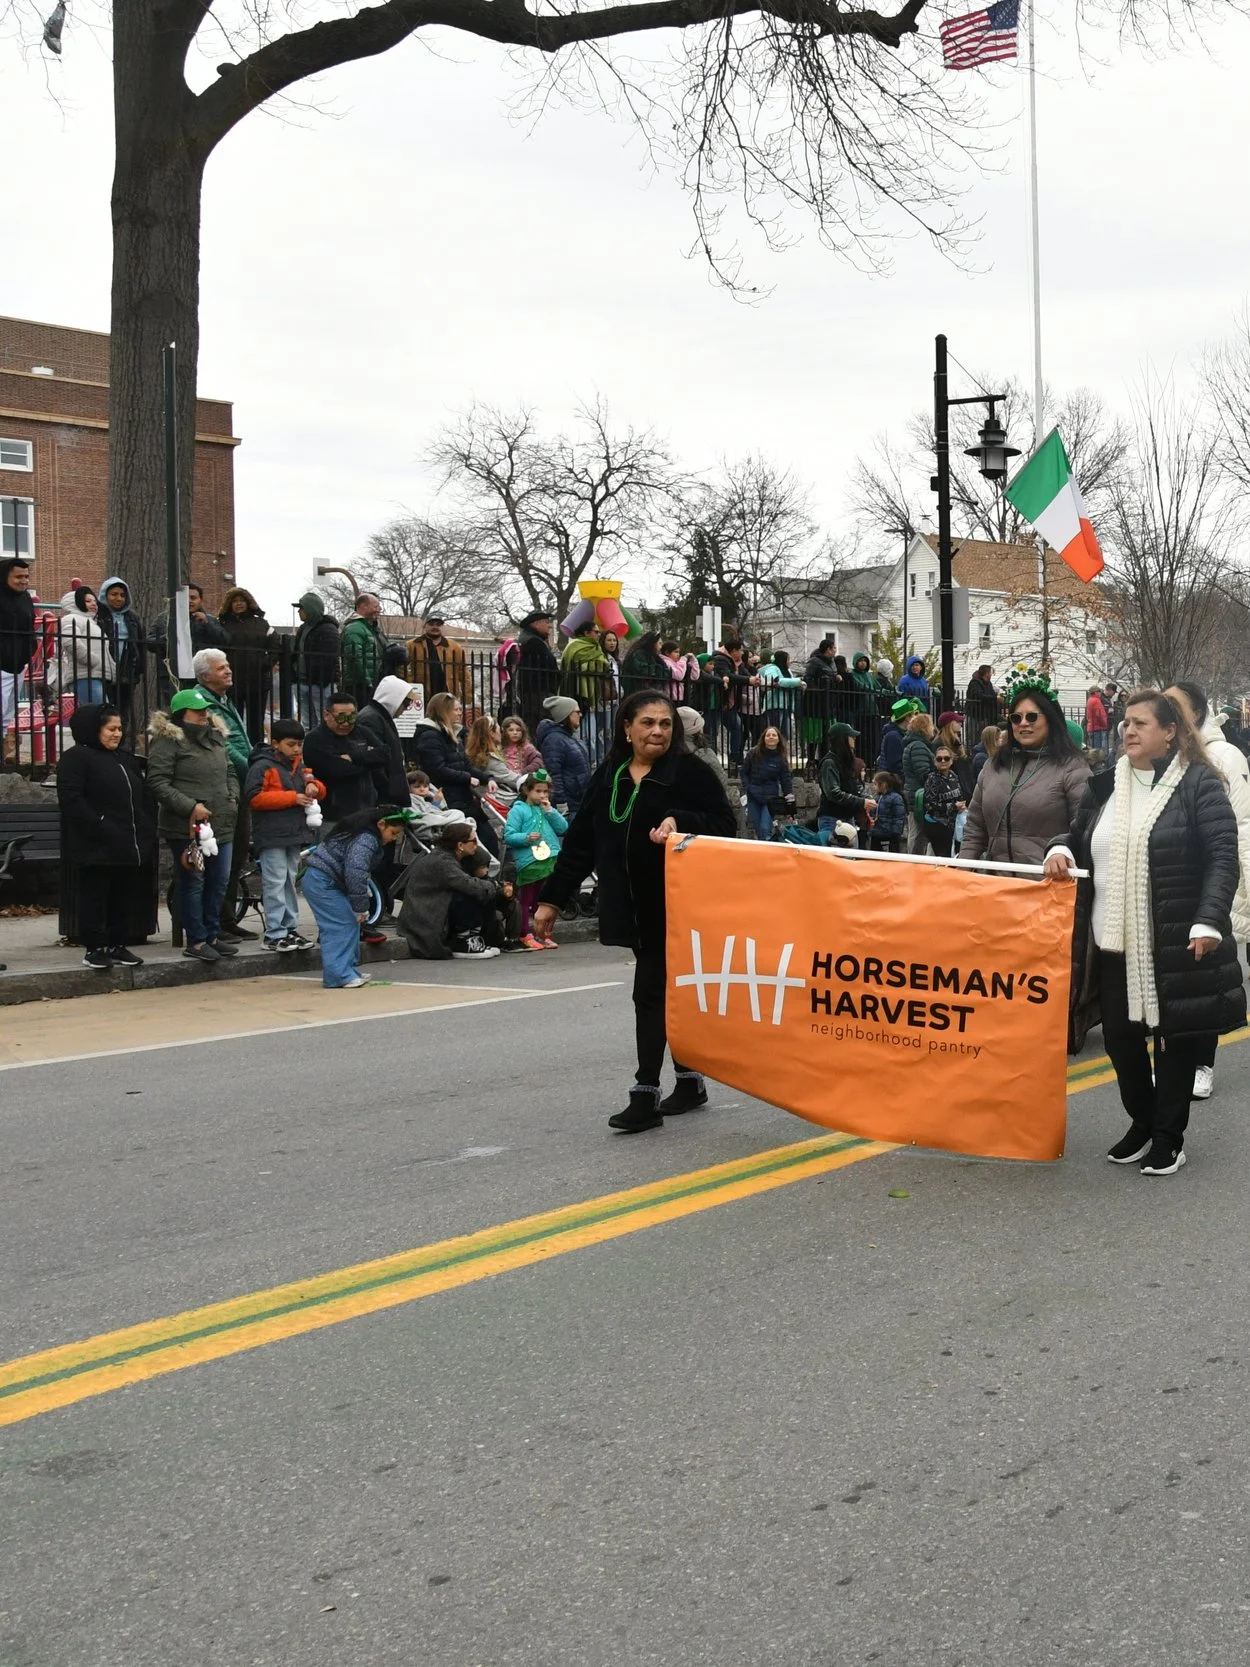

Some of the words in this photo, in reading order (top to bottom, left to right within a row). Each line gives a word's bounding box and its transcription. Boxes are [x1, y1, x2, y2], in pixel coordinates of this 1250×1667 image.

[811, 951, 1049, 1004] HORSEMAN'S
[811, 988, 975, 1032] HARVEST
[811, 1022, 922, 1048] neighborhood
[928, 1039, 982, 1059] pantry
